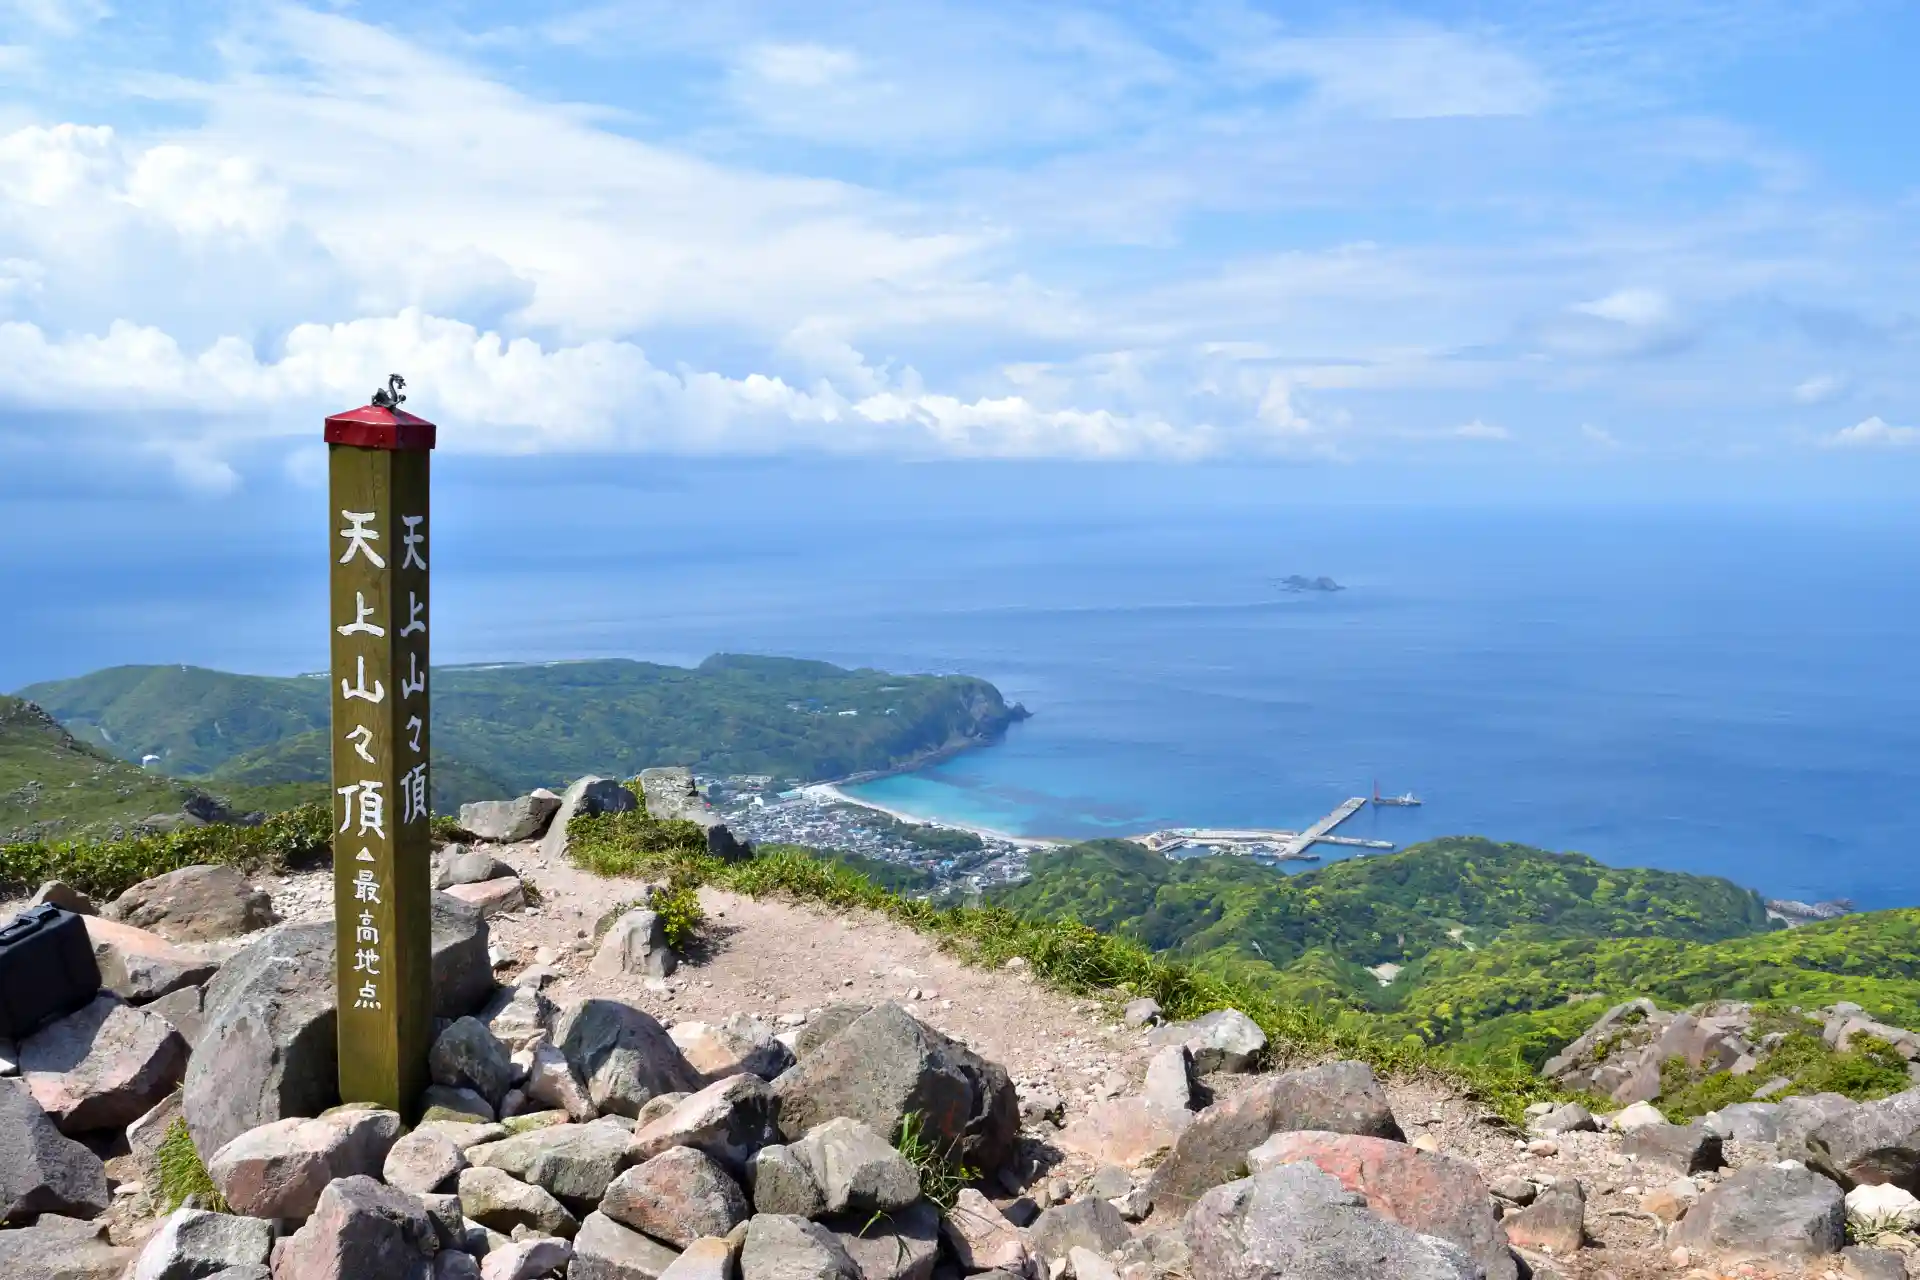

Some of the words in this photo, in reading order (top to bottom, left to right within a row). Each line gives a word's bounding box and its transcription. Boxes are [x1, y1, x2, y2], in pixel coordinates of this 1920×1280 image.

[336, 509, 386, 840] 天上山々頂
[400, 514, 427, 825] 天上山々頂
[352, 869, 381, 1010] 最高地点
